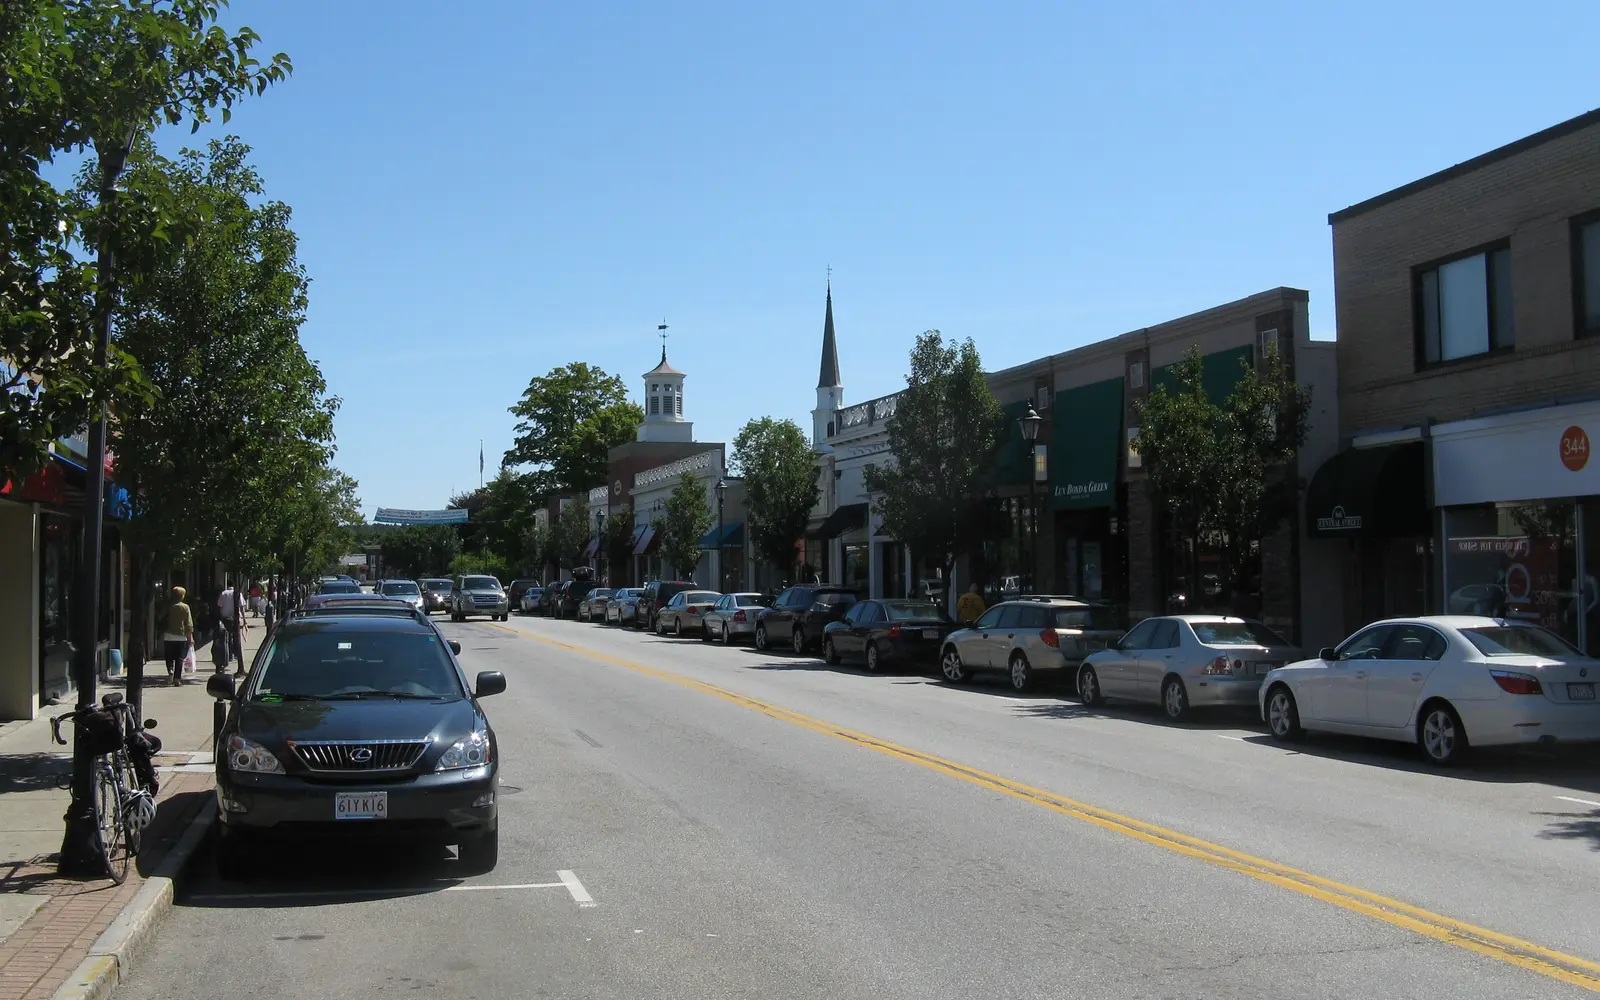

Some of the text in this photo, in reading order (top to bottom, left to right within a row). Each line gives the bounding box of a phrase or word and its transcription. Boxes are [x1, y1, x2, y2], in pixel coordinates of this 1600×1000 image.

[1563, 436, 1585, 455] 344
[1067, 484, 1083, 495] BOND
[1088, 481, 1108, 493] GREEN
[338, 799, 384, 813] 61YK16
